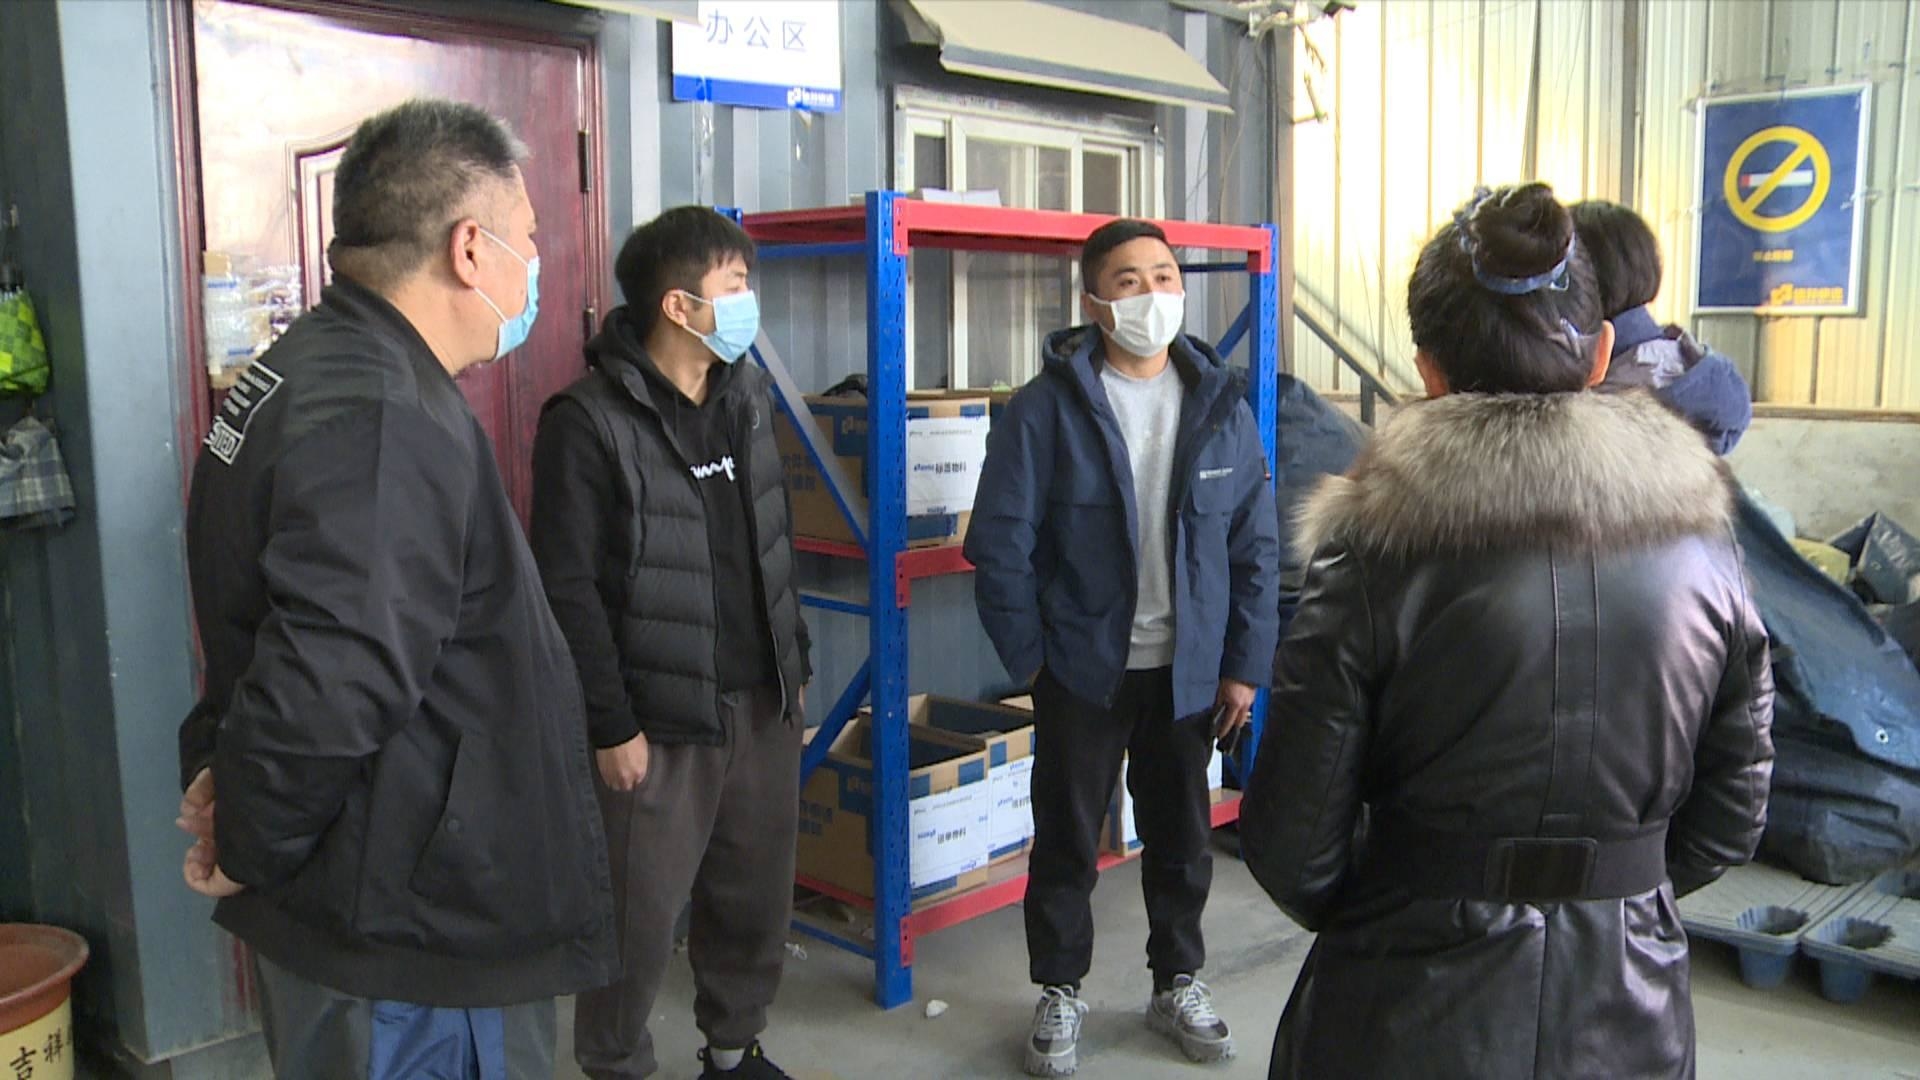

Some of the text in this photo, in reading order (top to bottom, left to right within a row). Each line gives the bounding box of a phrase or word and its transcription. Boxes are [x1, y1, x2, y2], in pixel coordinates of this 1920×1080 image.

[706, 8, 807, 52] 办公区
[9, 1026, 71, 1080] 吉祥
